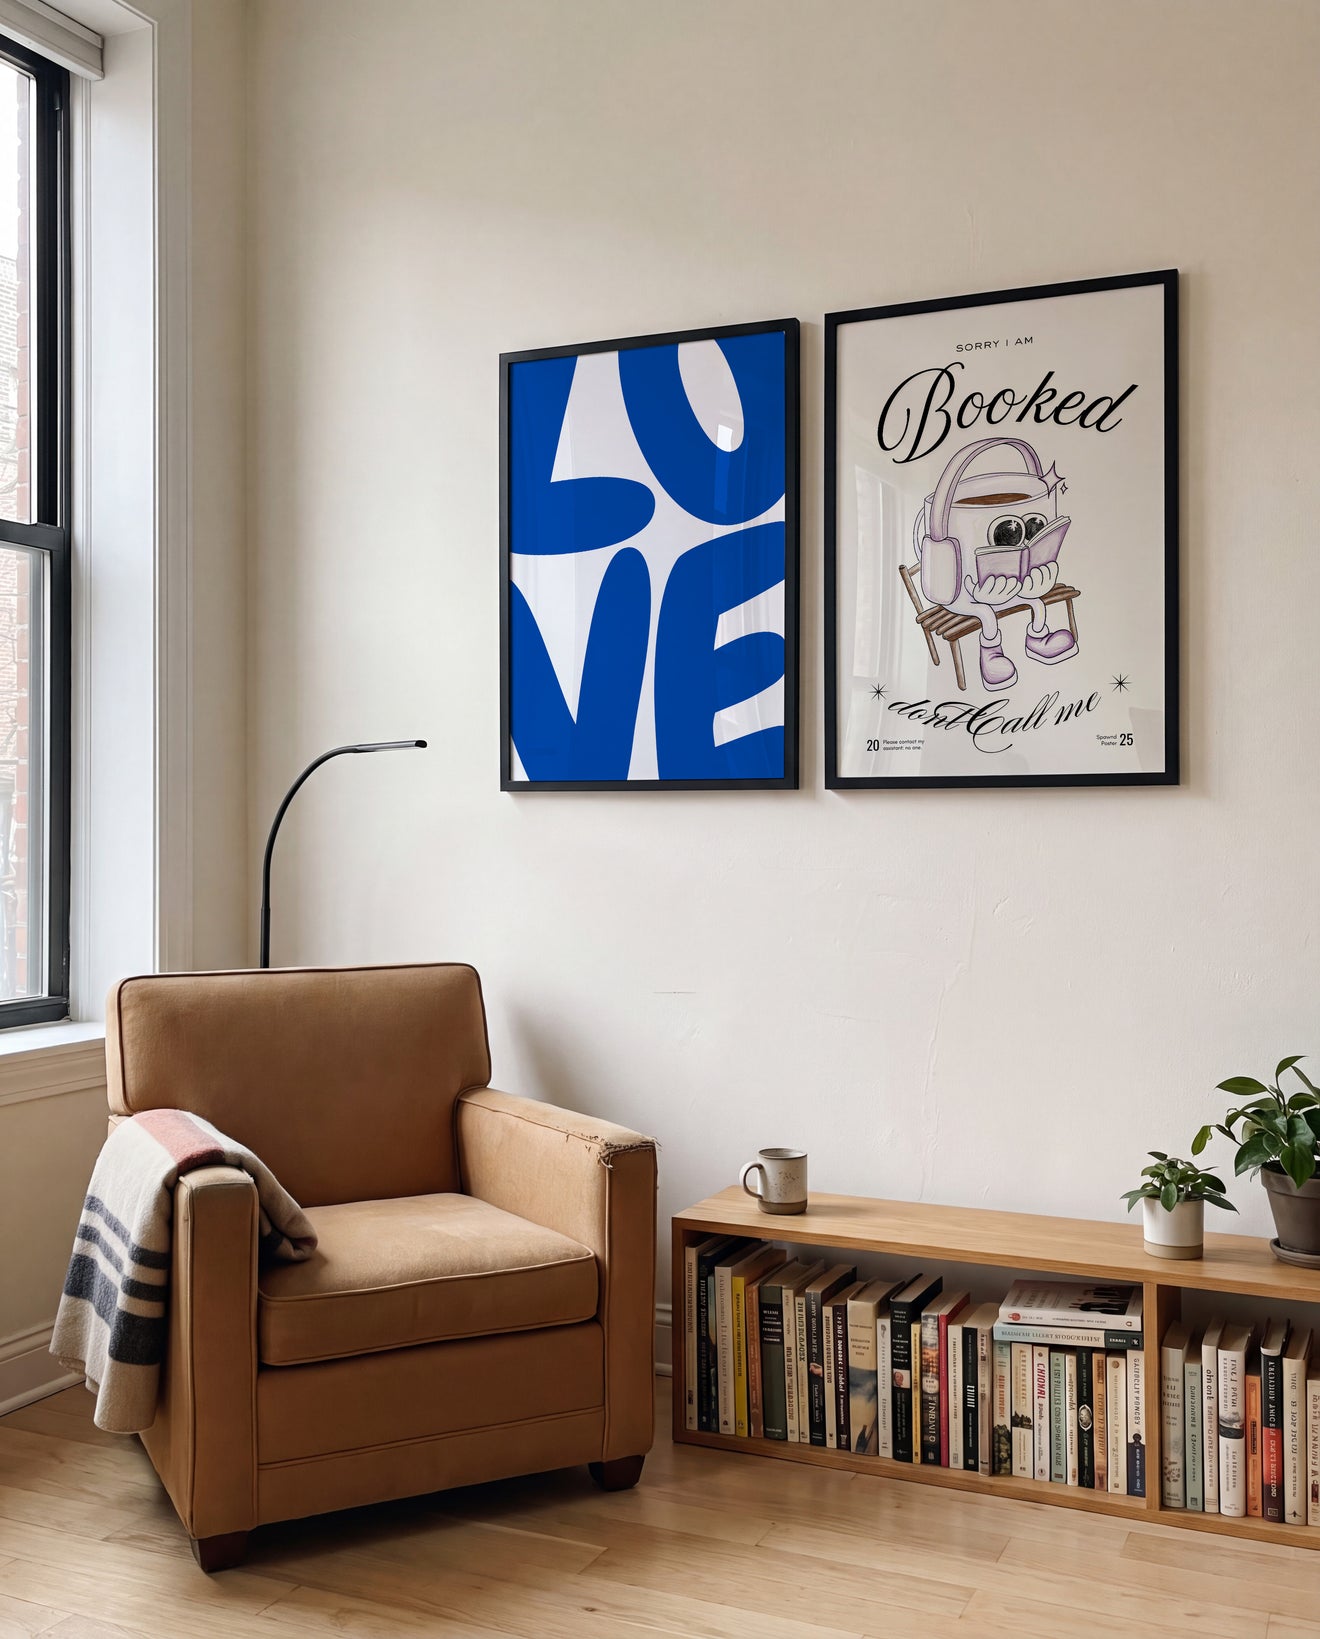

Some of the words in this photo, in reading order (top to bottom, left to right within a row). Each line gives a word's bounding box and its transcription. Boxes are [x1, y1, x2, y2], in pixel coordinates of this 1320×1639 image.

[956, 340, 999, 352] SORRY
[1014, 336, 1033, 346] AM
[877, 361, 1139, 464] Booked
[966, 690, 1060, 754] Call
[1054, 691, 1102, 726] me
[866, 739, 880, 752] 20
[1119, 733, 1134, 746] 25
